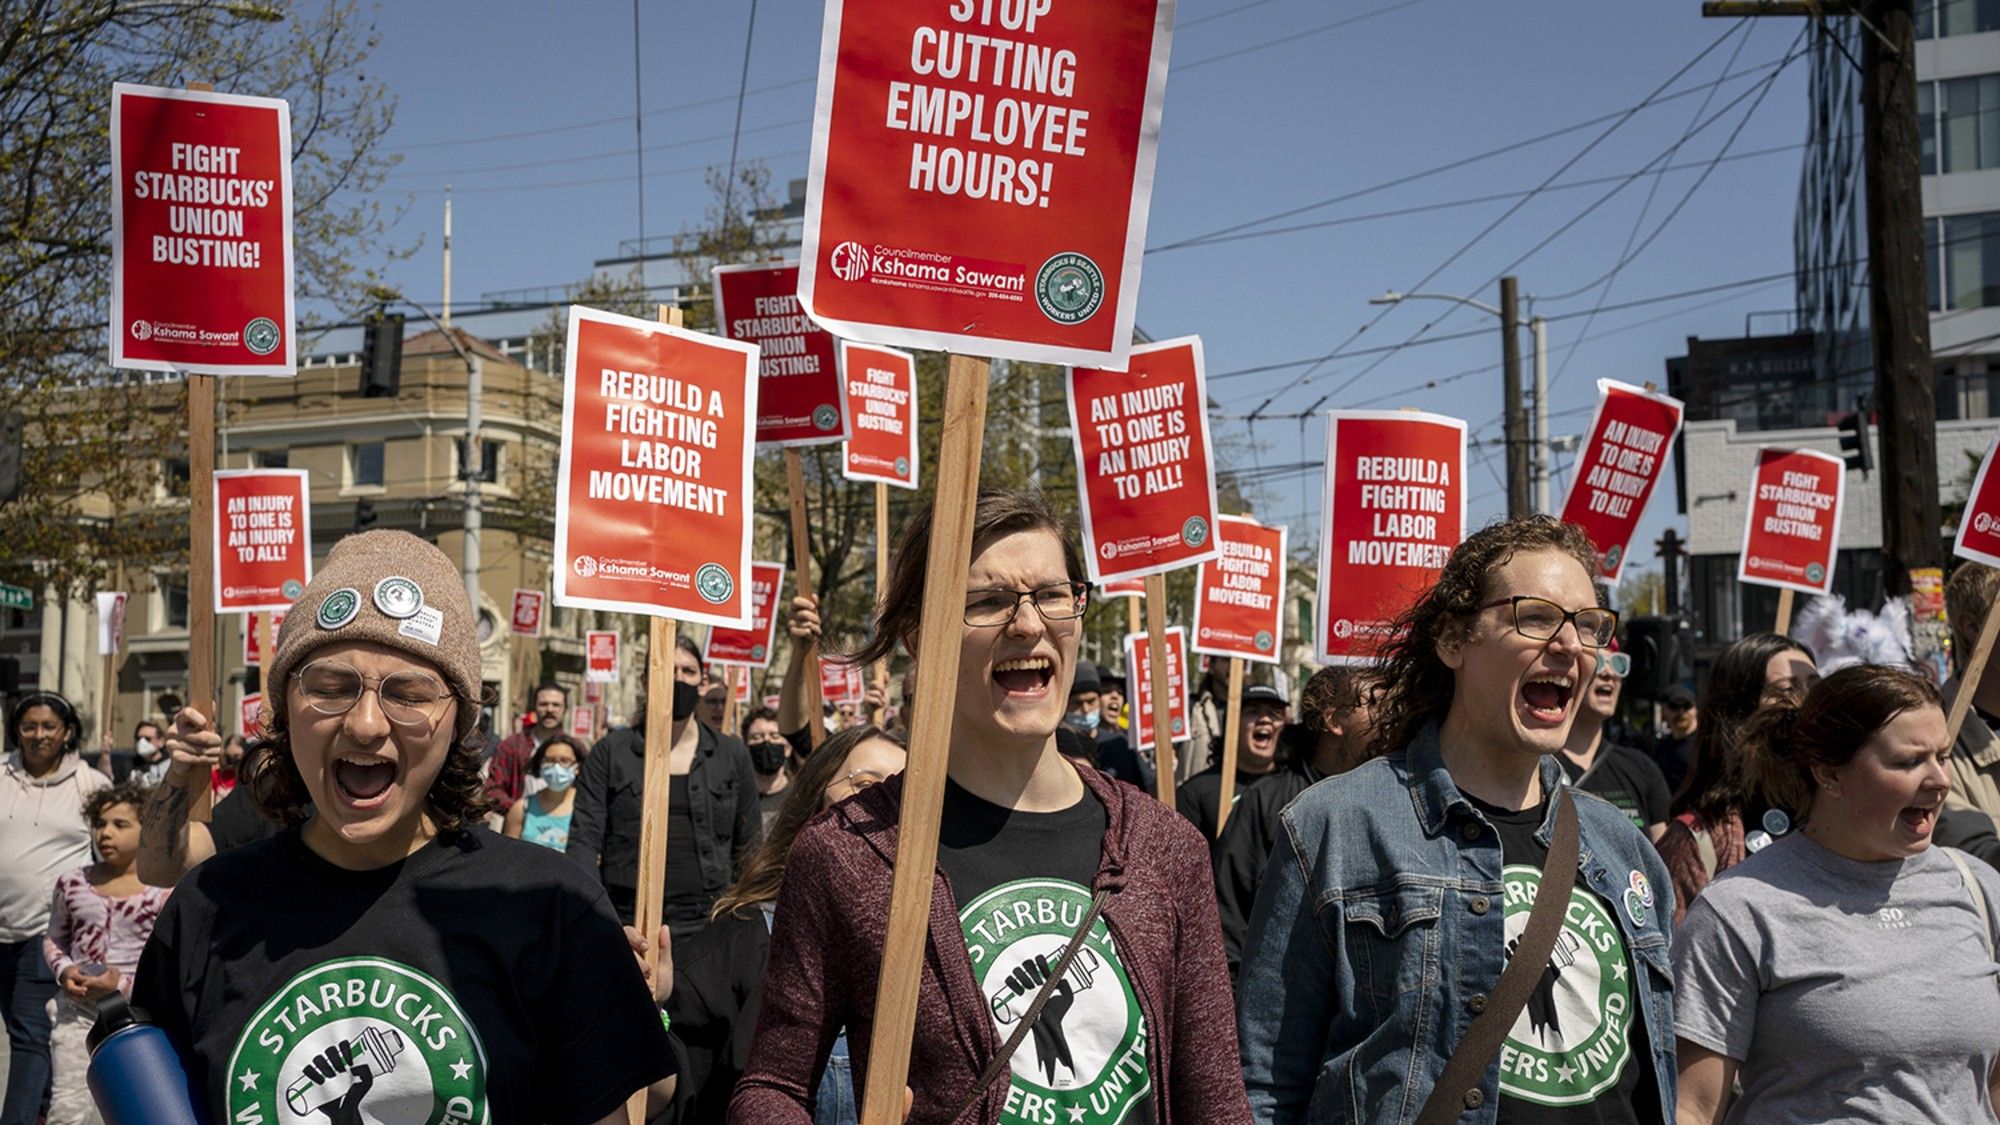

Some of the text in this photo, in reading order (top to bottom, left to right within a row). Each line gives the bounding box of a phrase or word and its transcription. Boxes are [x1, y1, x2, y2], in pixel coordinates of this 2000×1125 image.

[911, 26, 1077, 97] CUTTING
[886, 81, 1089, 157] EMPLOYEE
[172, 142, 241, 175] FIGHT
[134, 171, 274, 208] STARBUCKS'
[909, 143, 1053, 208] HOURS!
[169, 206, 244, 237] UNION
[153, 235, 260, 268] BUSTING!
[873, 244, 953, 264] Councilmember
[871, 256, 1026, 291] Kshama Sawant
[1039, 258, 1069, 293] STARBUCKS
[755, 295, 798, 316] FIGHT
[1042, 292, 1100, 320] WORKERS UNITED
[758, 336, 806, 357] UNION
[760, 355, 820, 377] USTING!
[867, 368, 895, 386] FIGHT
[600, 368, 725, 418] REBUILD A
[1091, 382, 1185, 423] AN INJURY
[865, 400, 896, 417] UNION
[605, 403, 717, 449] FIGHTING
[857, 414, 903, 435] BUSTING!
[1096, 410, 1186, 449] TO ONE IS
[1603, 420, 1664, 455] AN INJURY
[620, 439, 701, 479] LABOR
[1099, 436, 1191, 477] AN INJURY
[1357, 456, 1450, 486] REBUILD A
[1599, 443, 1655, 477] TO ONE IS
[589, 470, 728, 516] MOVEMENT
[1113, 465, 1184, 500] TO ALL!
[1586, 465, 1649, 499] AN INJURY
[1783, 471, 1820, 489] FIGHT
[227, 495, 294, 514] AN INJURY
[1361, 485, 1446, 513] FIGHTING
[1589, 490, 1633, 520] TO ALL!
[1759, 485, 1835, 510] STARBUCKS'
[230, 512, 292, 530] TO ONE IS
[1373, 513, 1436, 540] LABOR
[1776, 503, 1816, 523] UNION
[228, 528, 295, 547] AN INJURY
[1764, 516, 1823, 541] BUSTING!
[237, 545, 287, 563] TO ALL!
[1222, 541, 1273, 563] EBUILD A
[1348, 540, 1451, 570] MOVEMENT
[599, 563, 647, 577] Kshama
[649, 566, 690, 583] Sawant
[1217, 557, 1270, 578] FIGHTING
[1223, 572, 1262, 592] LABOR
[1208, 586, 1273, 610] MOVEMENT
[1503, 880, 1616, 953] RBCKS
[1880, 907, 1903, 922] 50
[967, 898, 1122, 965] TARBU
[259, 979, 457, 1055] STARBUCKS
[1573, 992, 1626, 1078] UNITED
